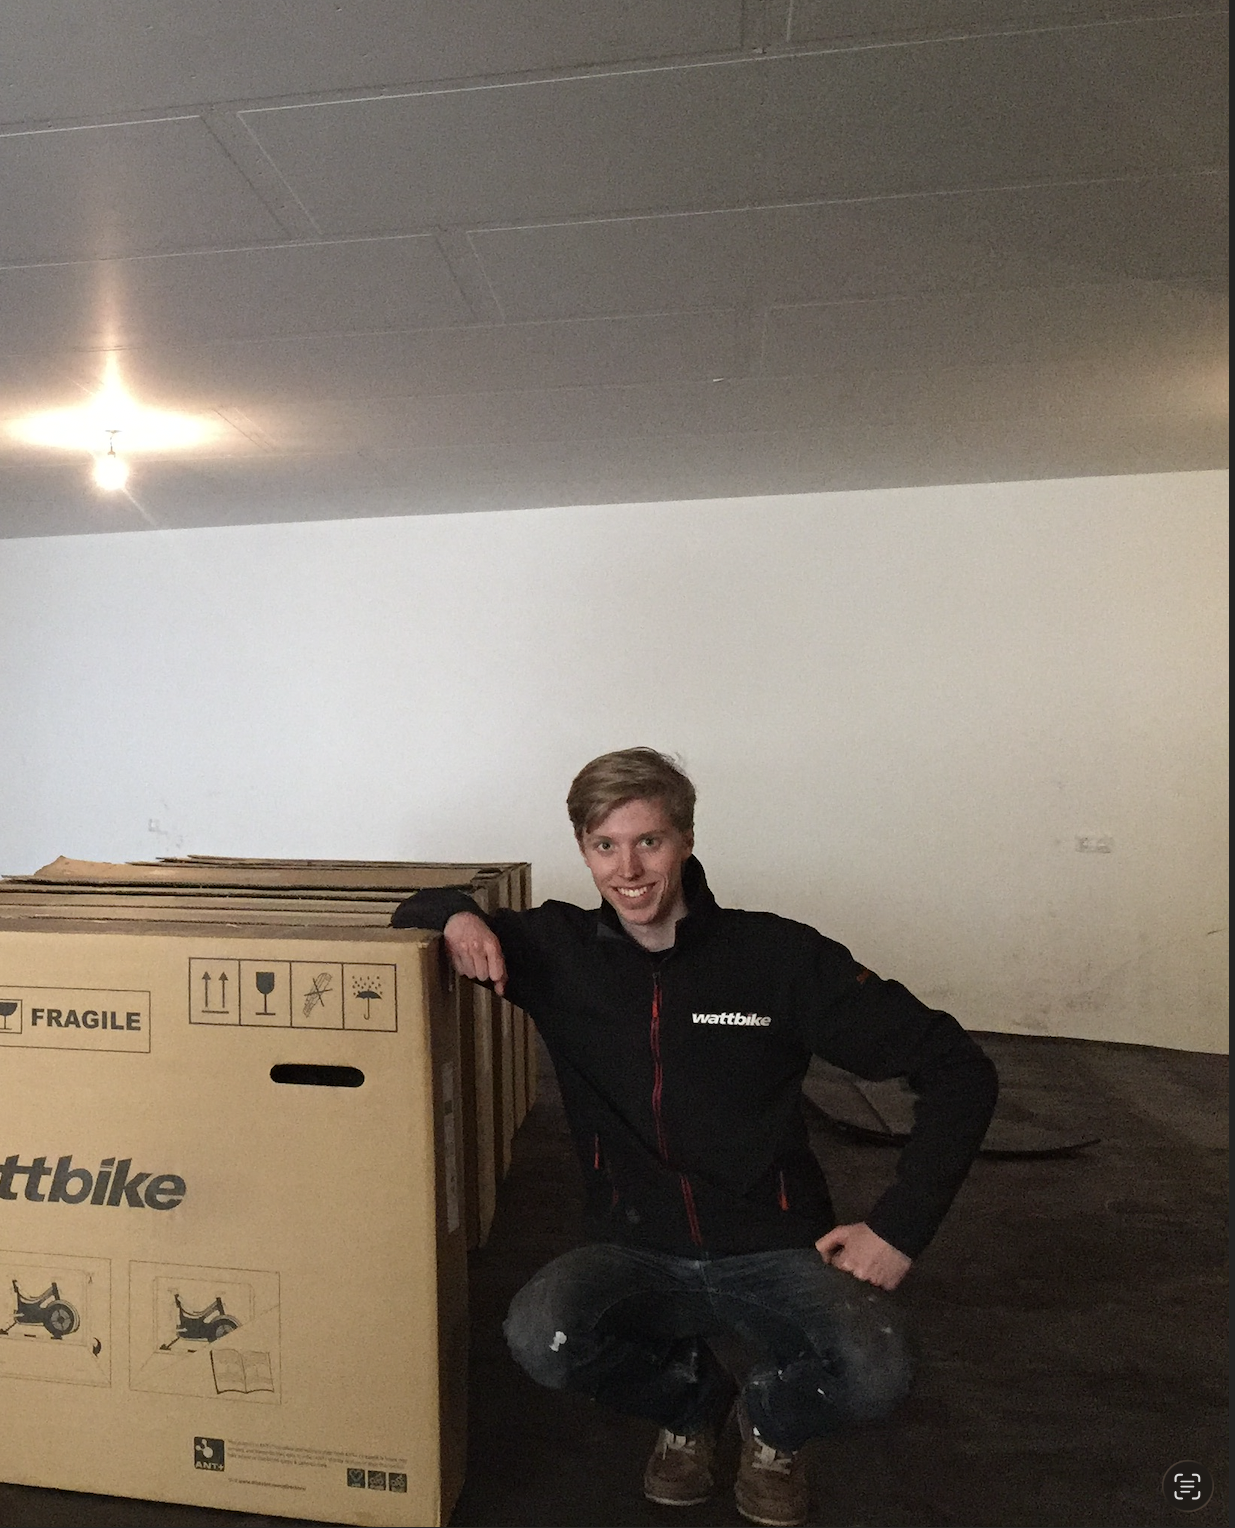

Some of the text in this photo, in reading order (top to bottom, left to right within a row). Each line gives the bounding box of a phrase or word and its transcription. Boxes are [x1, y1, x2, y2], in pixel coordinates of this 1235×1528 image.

[31, 1008, 141, 1031] FRAGILE
[691, 1011, 772, 1027] wattbike
[195, 1460, 224, 1471] ANT+
